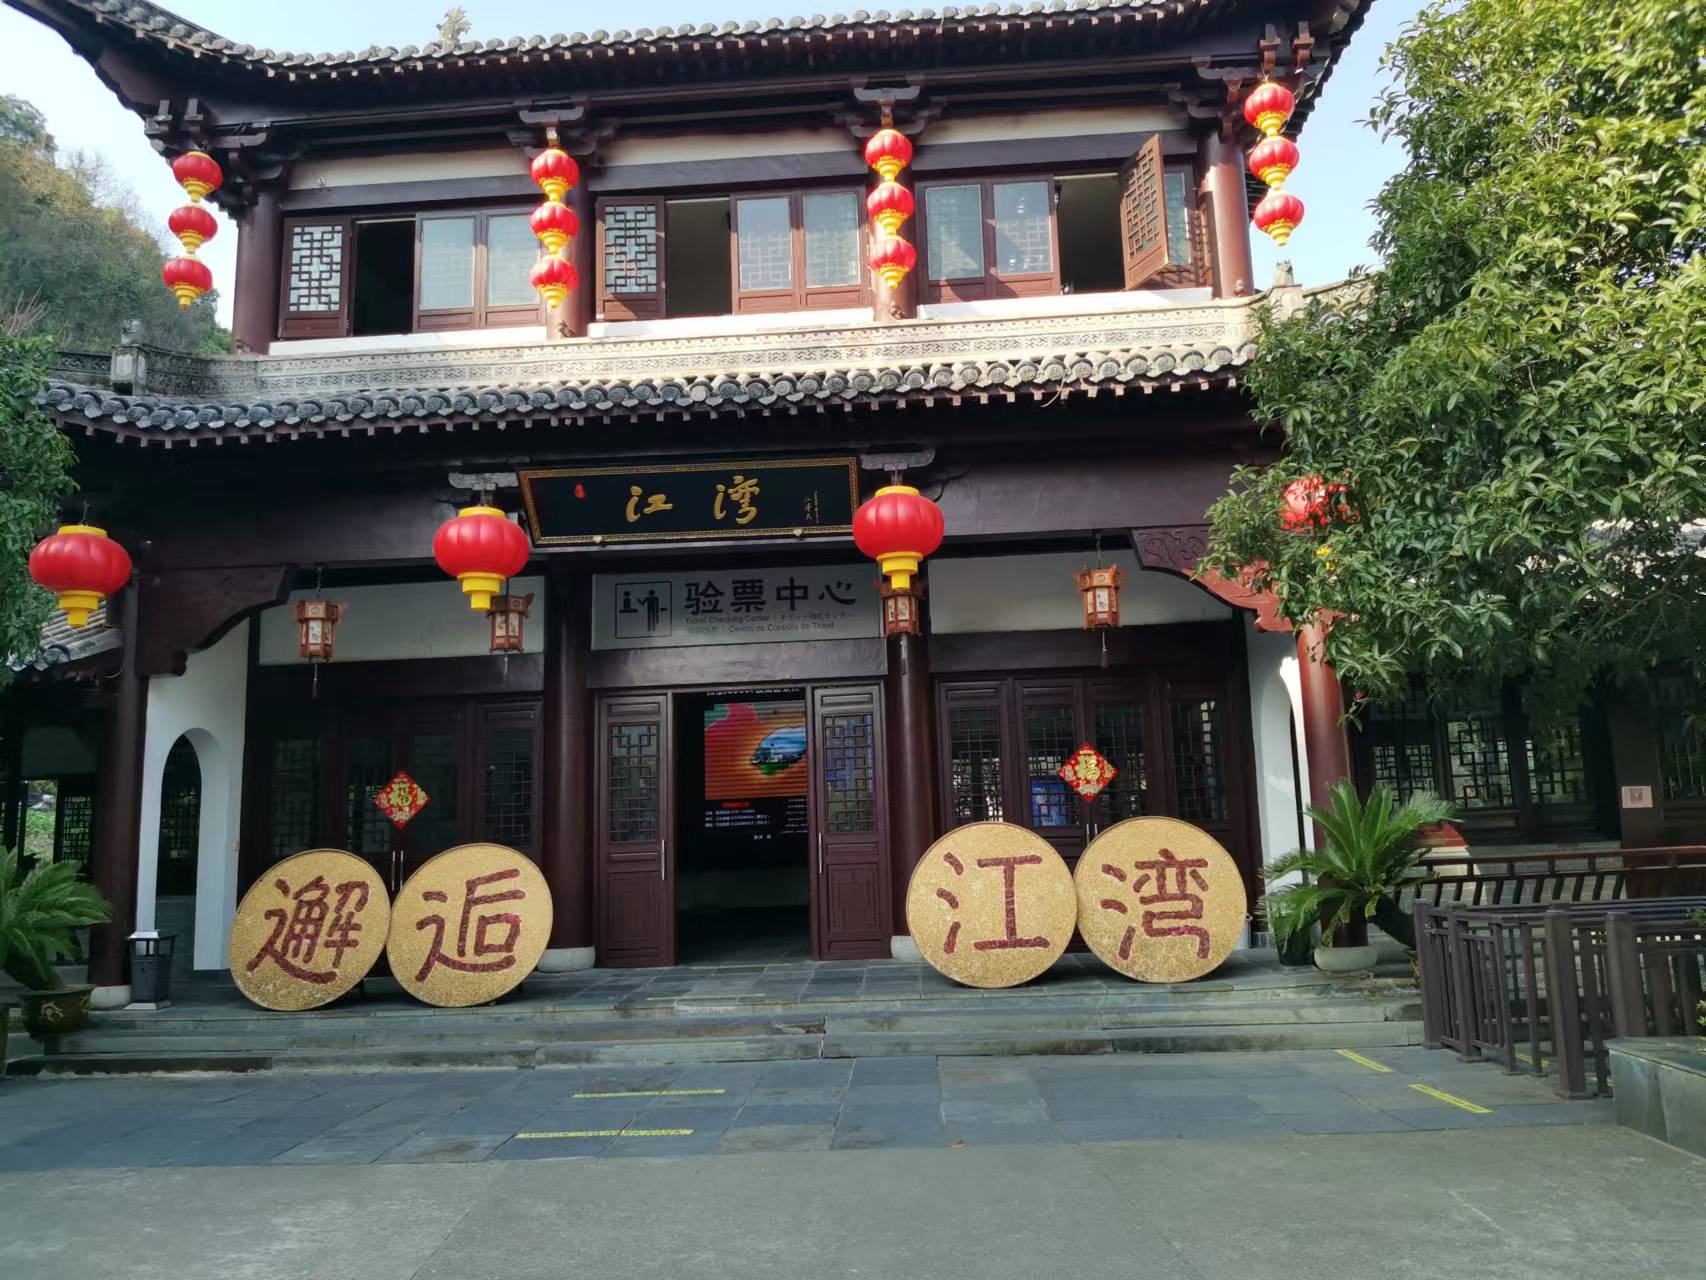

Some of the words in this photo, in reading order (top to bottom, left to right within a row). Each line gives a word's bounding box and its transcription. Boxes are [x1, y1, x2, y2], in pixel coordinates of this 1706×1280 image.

[684, 577, 857, 615] 验票中心
[1075, 754, 1101, 782] 福
[388, 782, 413, 808] 福
